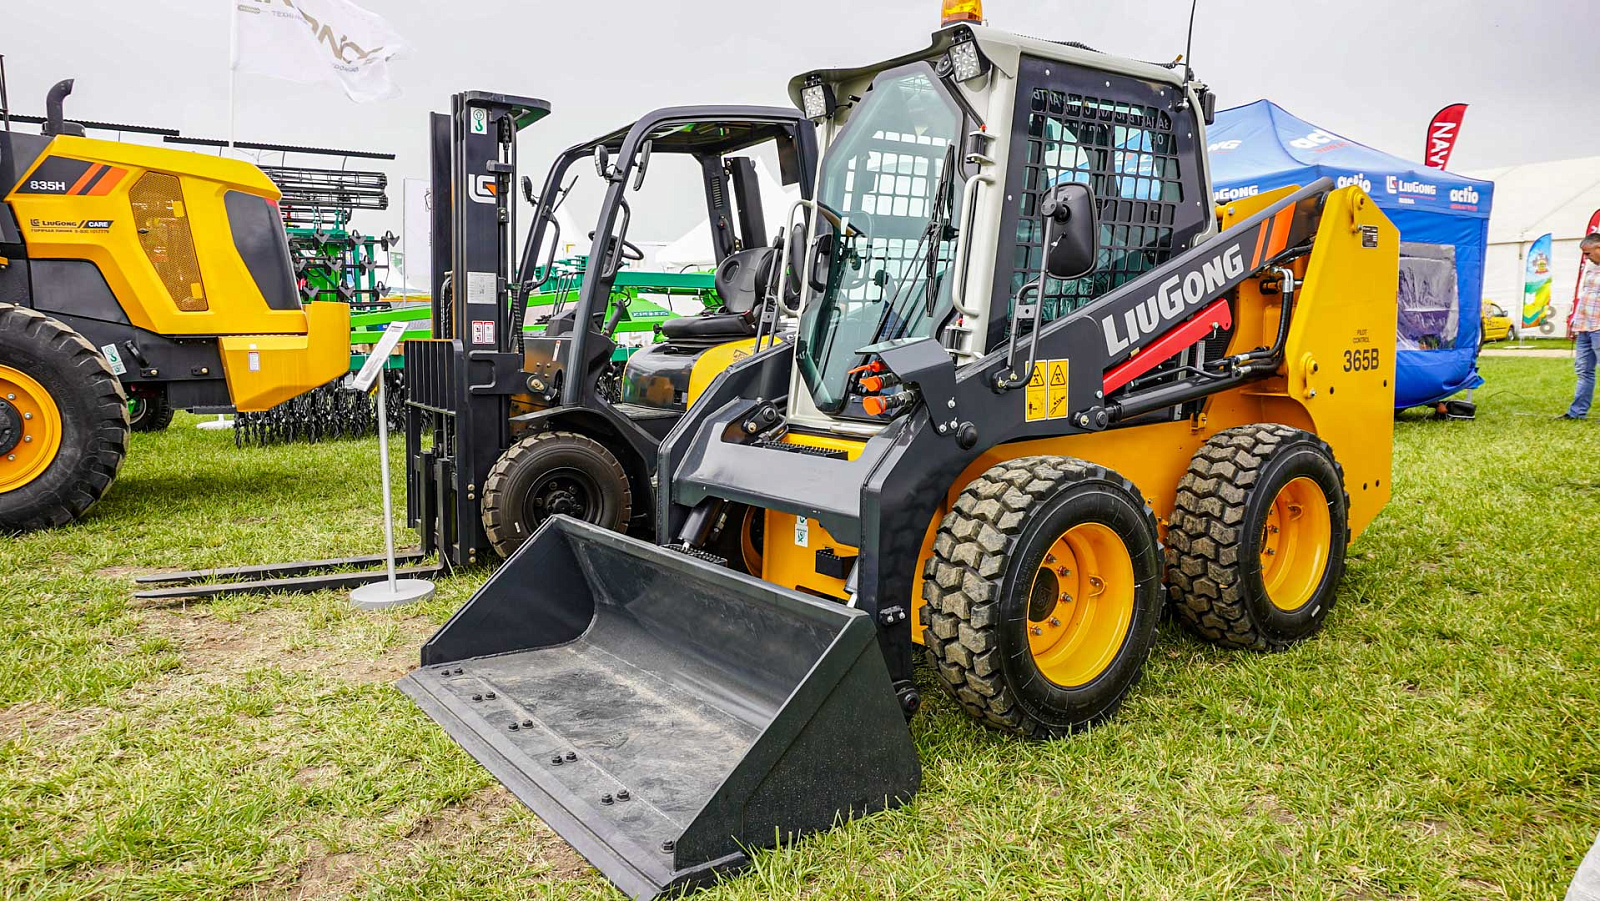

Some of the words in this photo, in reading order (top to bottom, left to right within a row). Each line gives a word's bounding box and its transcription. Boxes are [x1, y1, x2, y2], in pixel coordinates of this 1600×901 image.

[1430, 122, 1457, 168] NAV
[30, 180, 66, 191] 835H
[1449, 186, 1479, 204] actio
[1342, 348, 1380, 373] 365B
